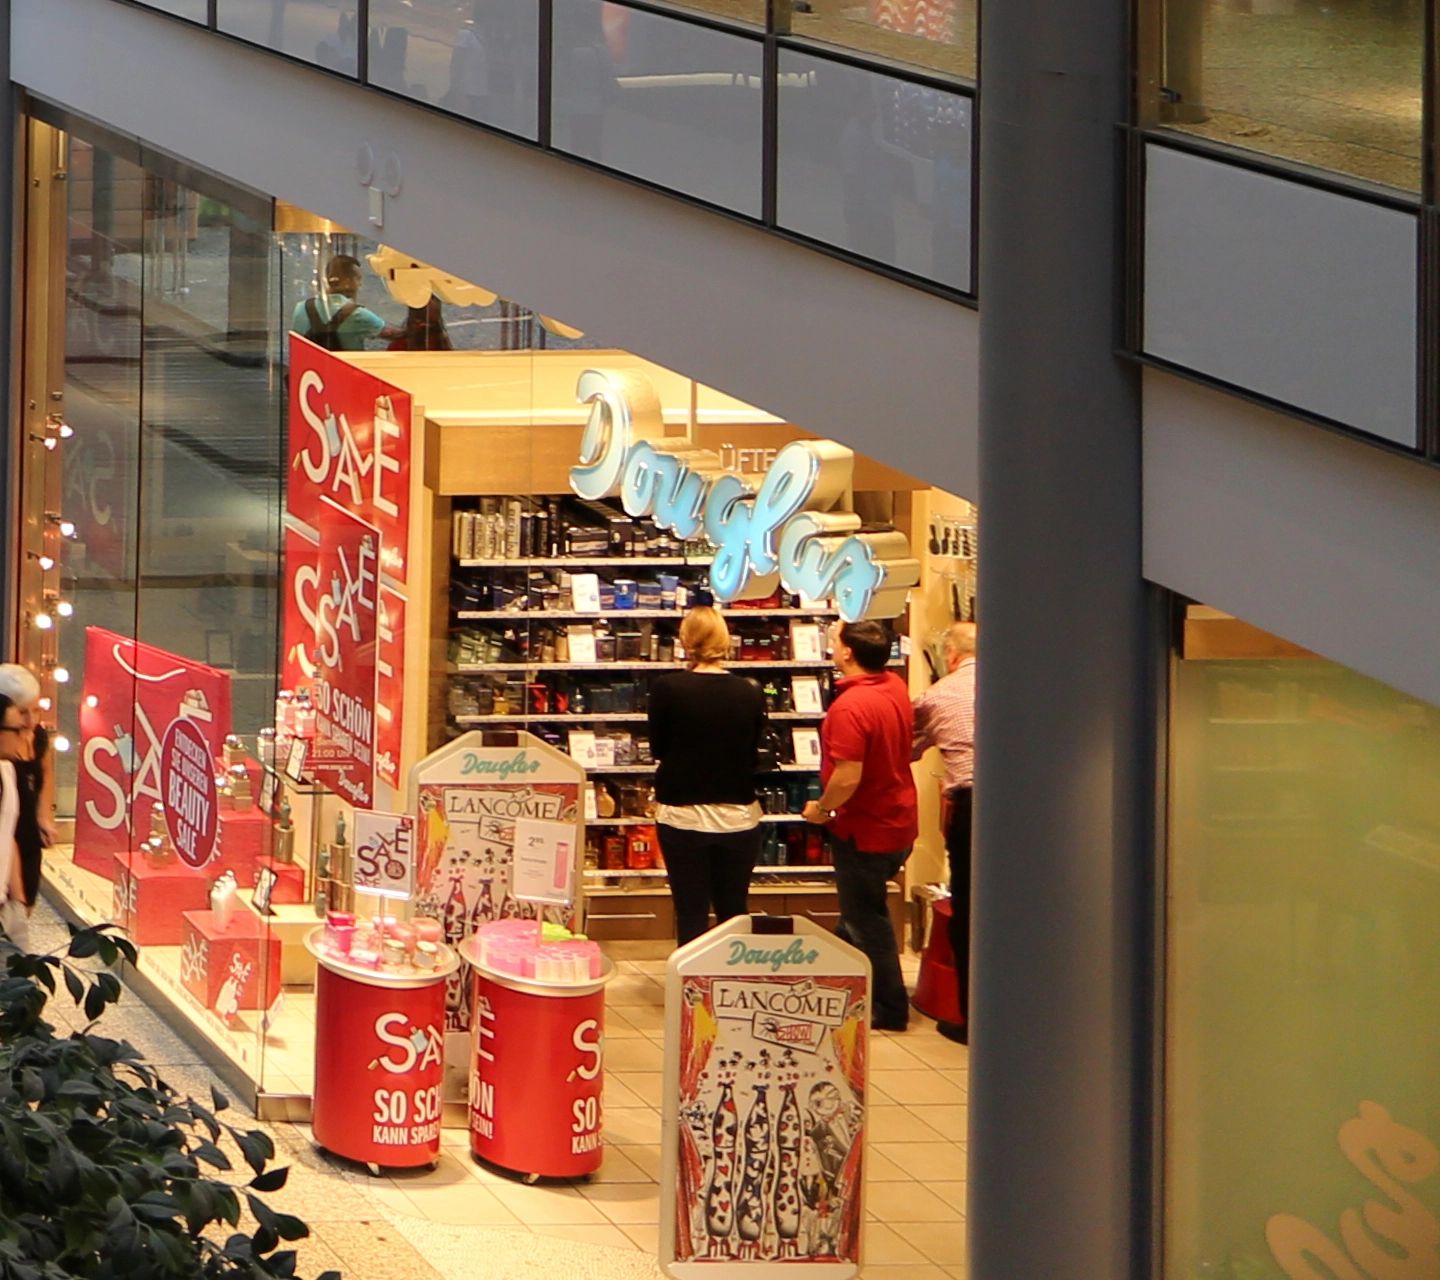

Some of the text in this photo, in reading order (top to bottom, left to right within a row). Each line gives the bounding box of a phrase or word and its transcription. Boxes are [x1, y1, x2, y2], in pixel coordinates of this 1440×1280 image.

[298, 370, 400, 517] SALE
[720, 443, 776, 473] ÜFTE
[569, 368, 894, 624] Douglas
[319, 542, 375, 668] SALE
[333, 688, 371, 745] SCHÖN
[460, 751, 541, 781] Douglas
[168, 769, 210, 837] BEAUTY
[177, 819, 197, 861] SALE
[357, 827, 409, 877] SALE
[726, 938, 819, 972] Douglas
[375, 1012, 444, 1074] SA
[373, 1083, 443, 1124] SO SCH
[572, 1096, 597, 1133] SO
[372, 1125, 408, 1145] KANN
